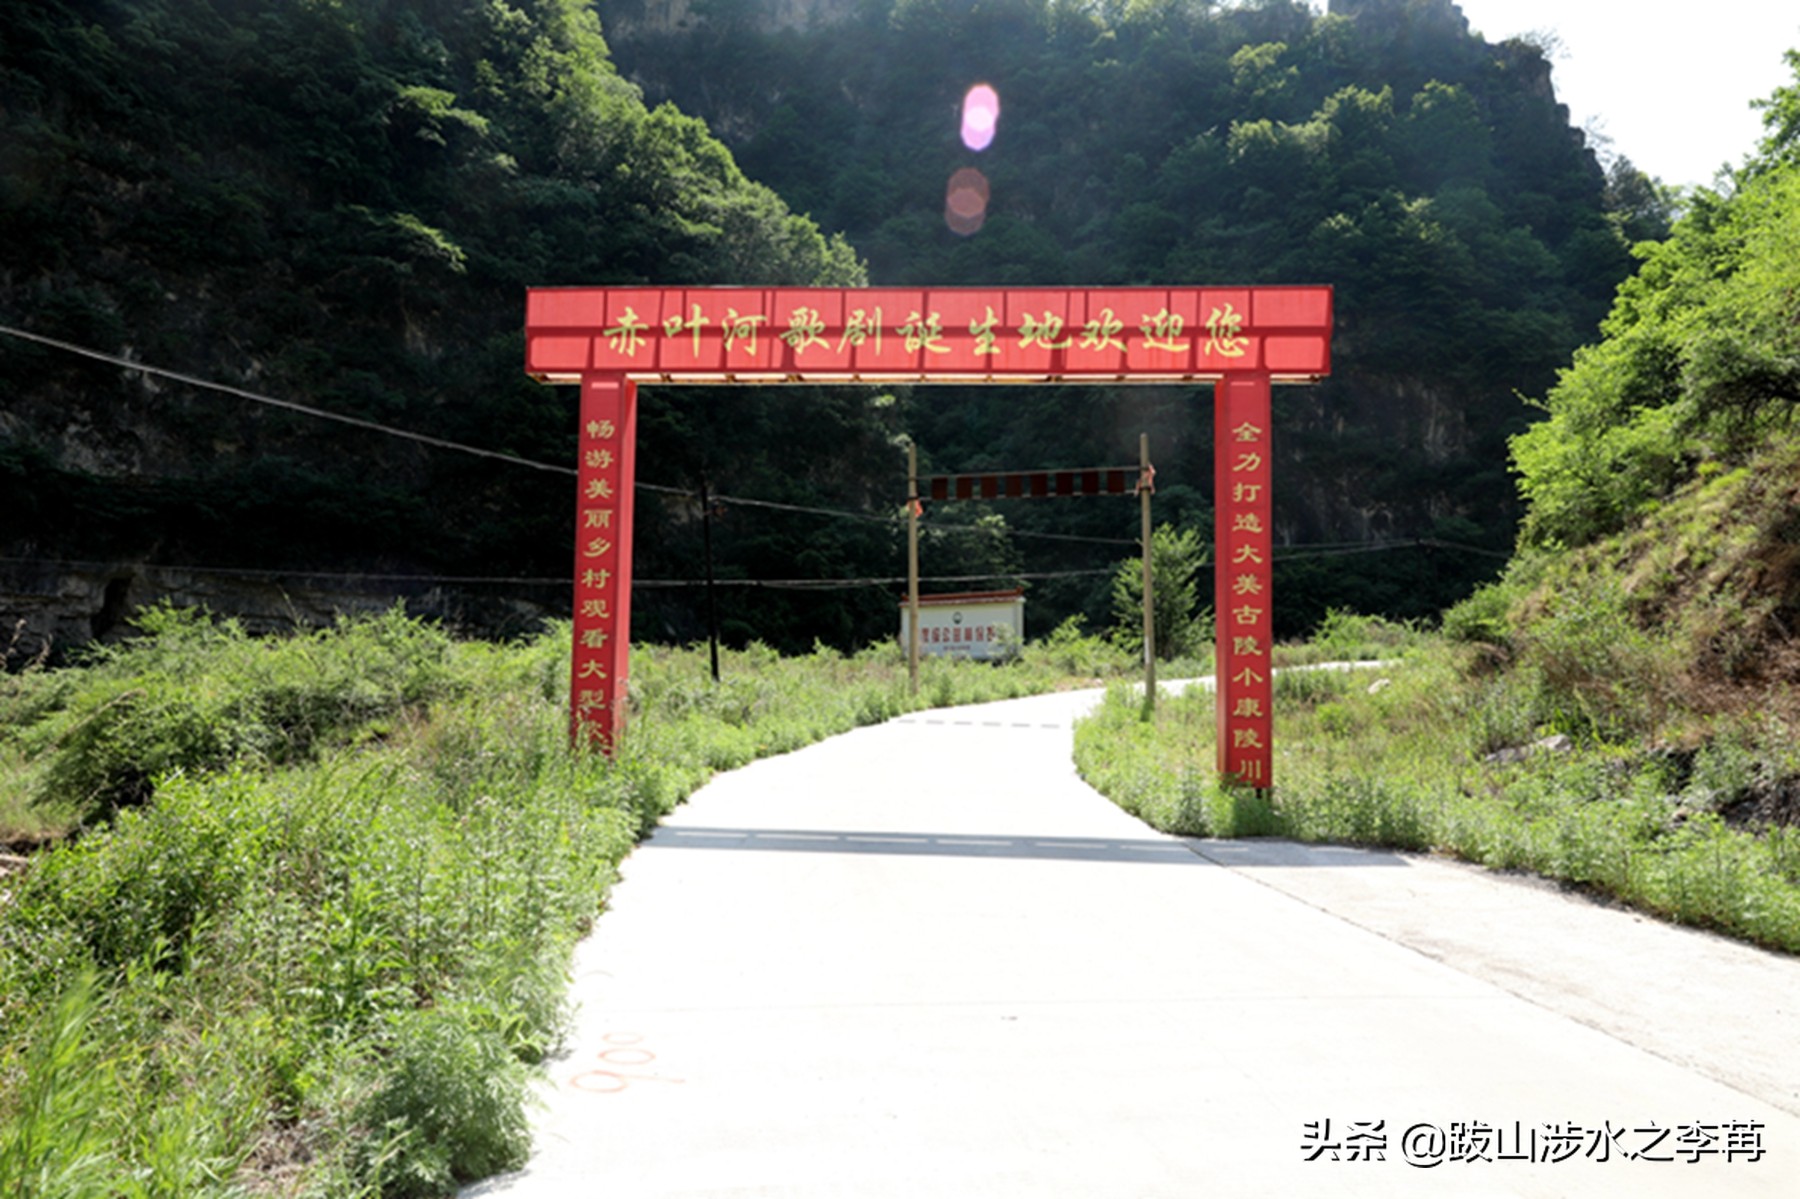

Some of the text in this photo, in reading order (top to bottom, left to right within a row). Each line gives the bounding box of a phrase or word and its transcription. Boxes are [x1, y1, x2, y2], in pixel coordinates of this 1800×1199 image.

[603, 303, 1250, 358] 赤叶河歌剧诞生地欢迎您
[1231, 421, 1264, 780] 全力打造大美古陵小康陵川
